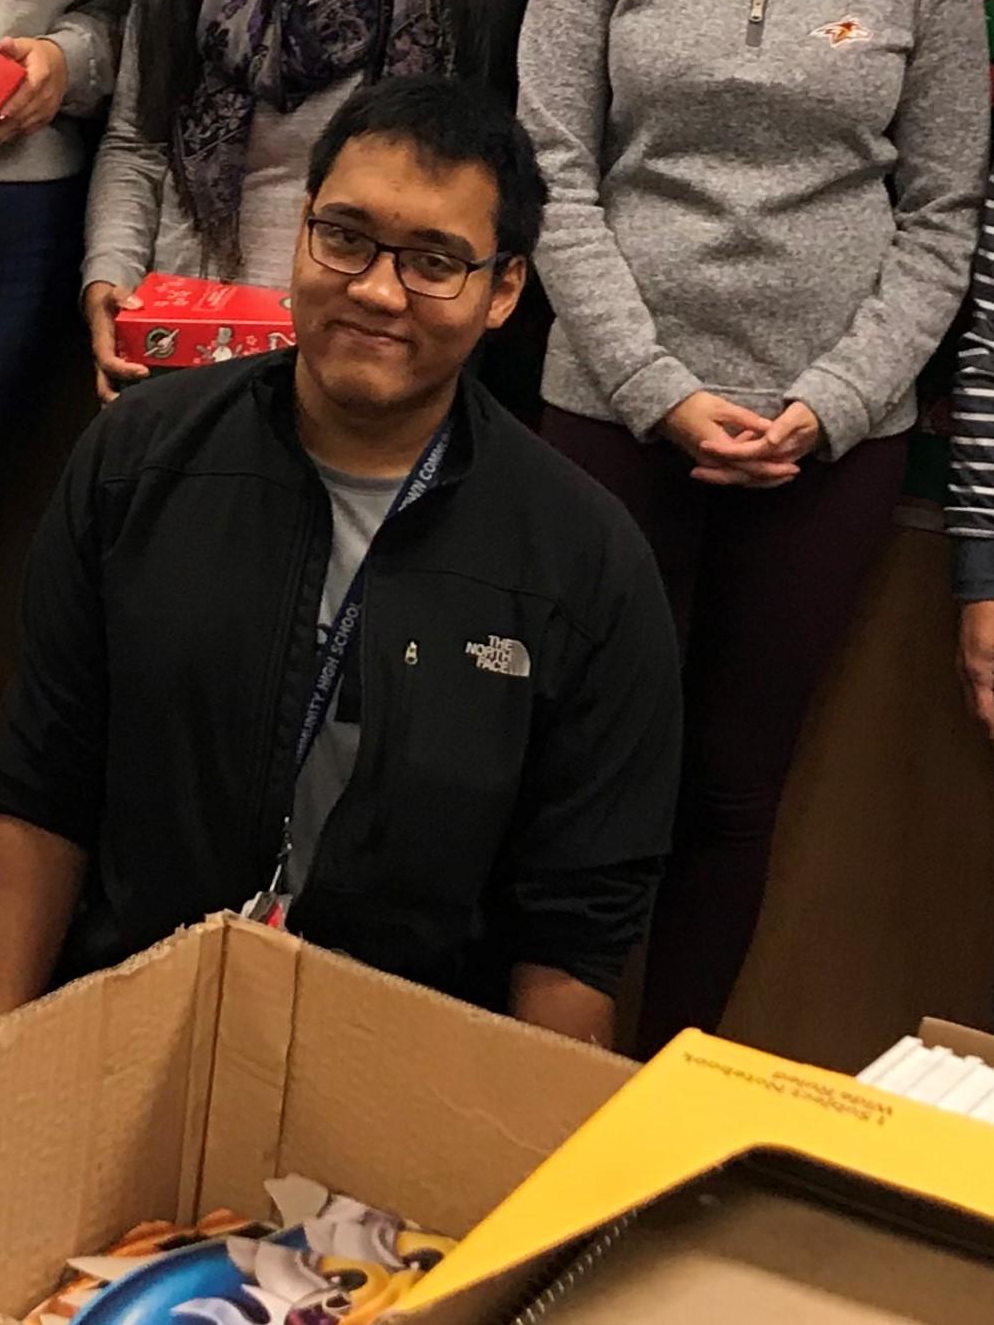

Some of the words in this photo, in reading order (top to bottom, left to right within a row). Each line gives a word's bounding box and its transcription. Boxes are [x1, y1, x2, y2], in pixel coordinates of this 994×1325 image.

[316, 656, 340, 692] HIGH
[330, 602, 363, 655] SCHOOL
[465, 641, 511, 662] NORTH
[488, 635, 513, 651] THE
[476, 656, 509, 674] FACE
[683, 1052, 785, 1093] Notebook
[791, 1089, 869, 1121] Subject
